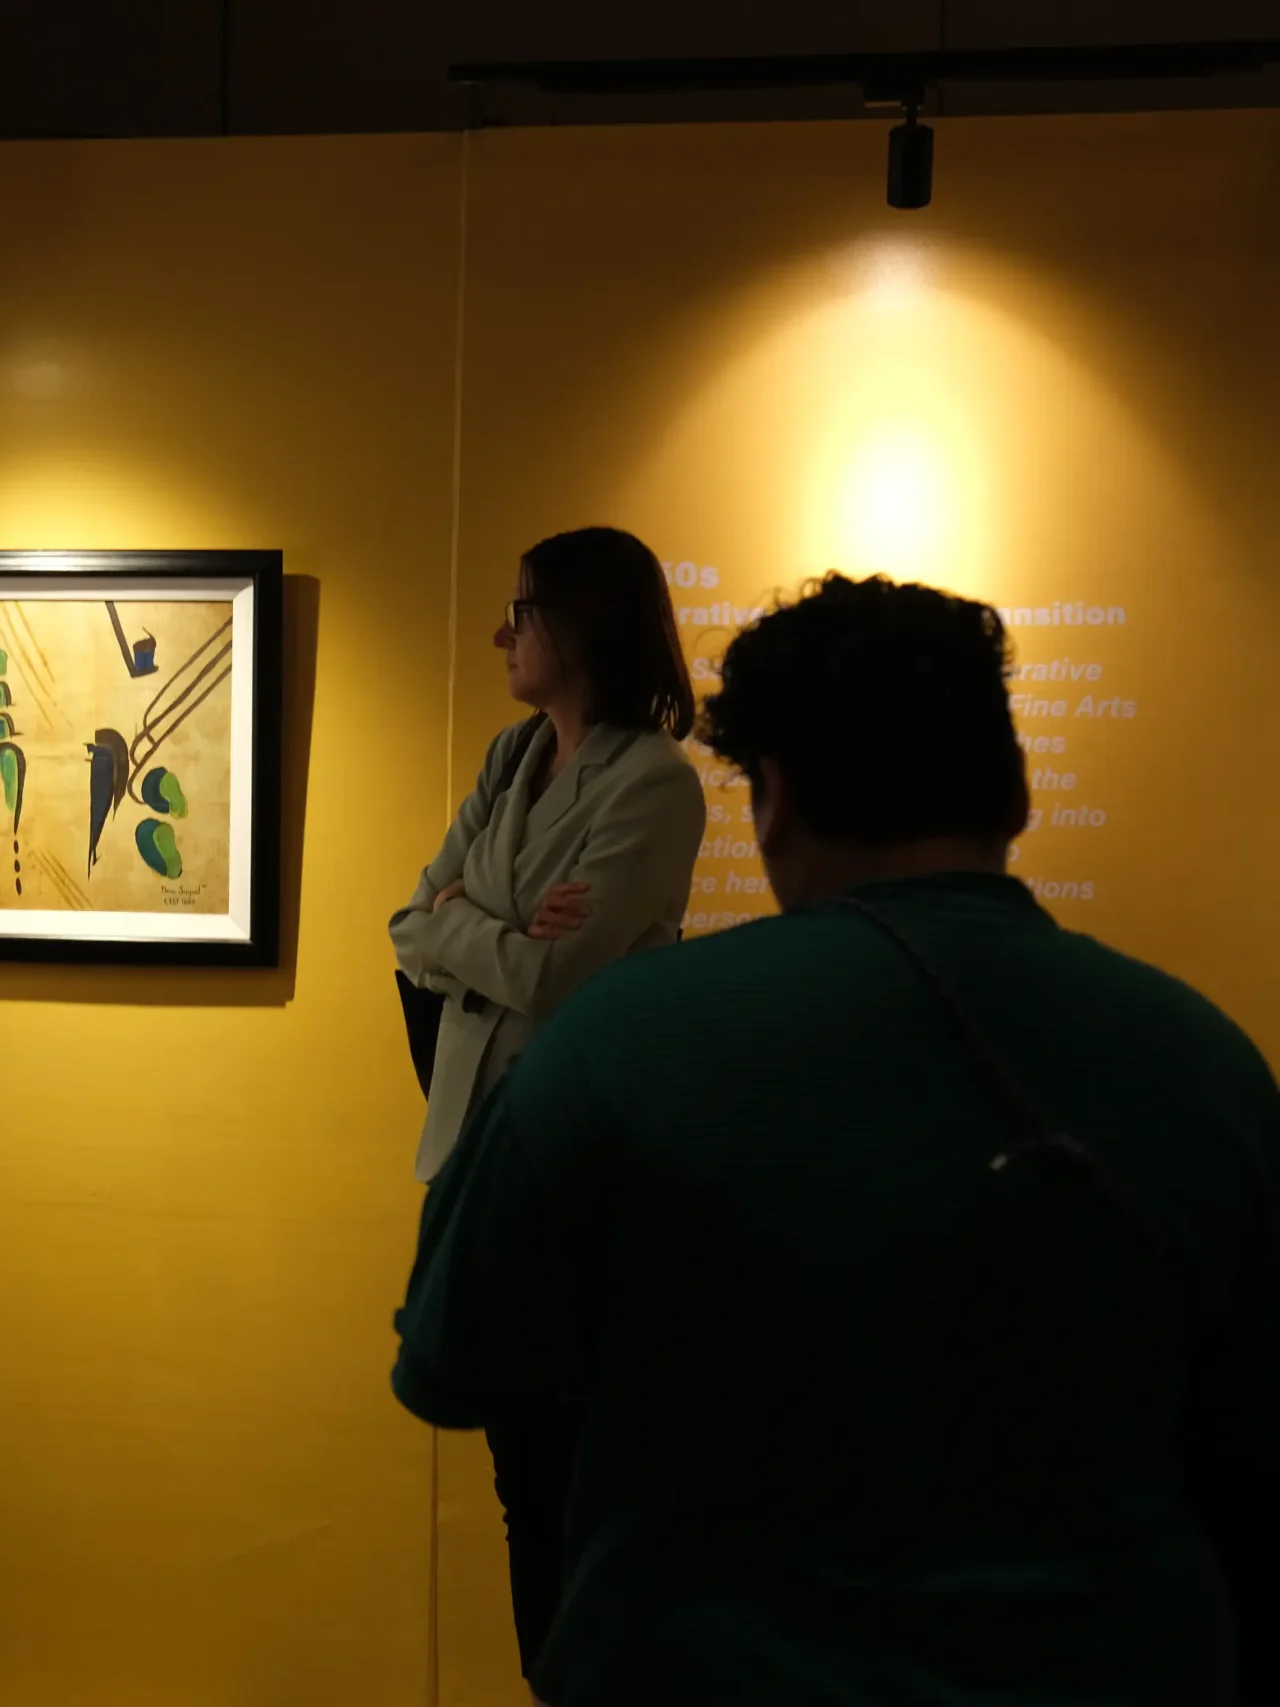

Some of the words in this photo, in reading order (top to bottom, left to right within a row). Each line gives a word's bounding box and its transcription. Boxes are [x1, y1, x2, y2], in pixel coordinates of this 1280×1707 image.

[1008, 694, 1068, 718] Fine
[1075, 694, 1137, 719] Arts
[1031, 766, 1077, 790] the
[1051, 803, 1107, 828] into
